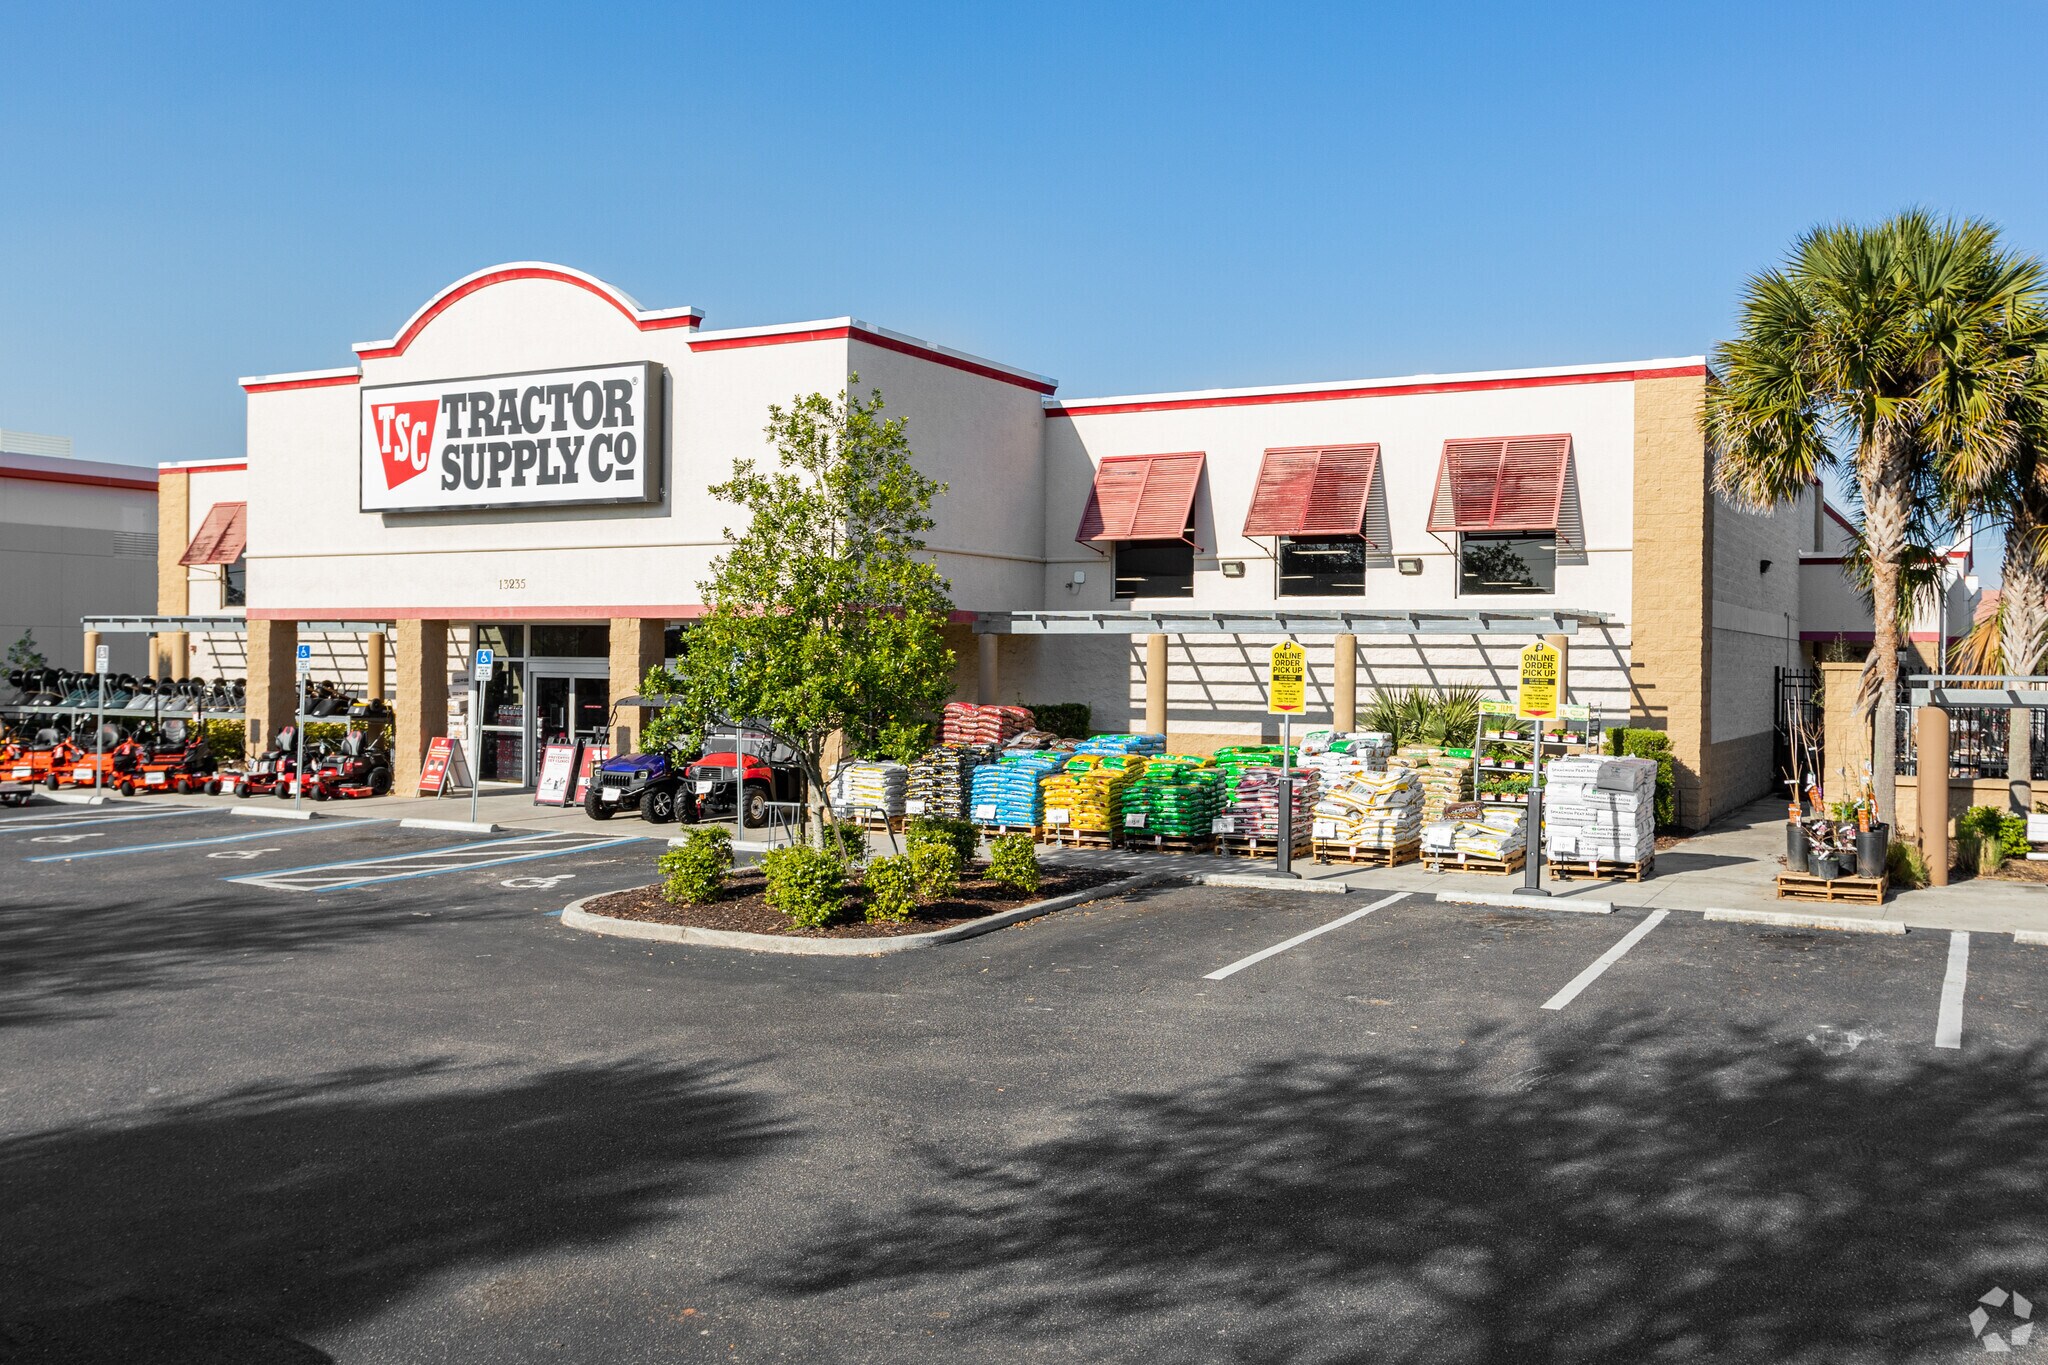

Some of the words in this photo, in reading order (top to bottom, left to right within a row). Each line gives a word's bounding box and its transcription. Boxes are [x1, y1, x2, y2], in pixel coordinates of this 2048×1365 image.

[442, 379, 634, 439] TRACTOR
[378, 406, 427, 471] TSC
[441, 436, 584, 491] SUPPLY
[499, 578, 526, 590] 13235
[1274, 652, 1302, 660] ONLINE
